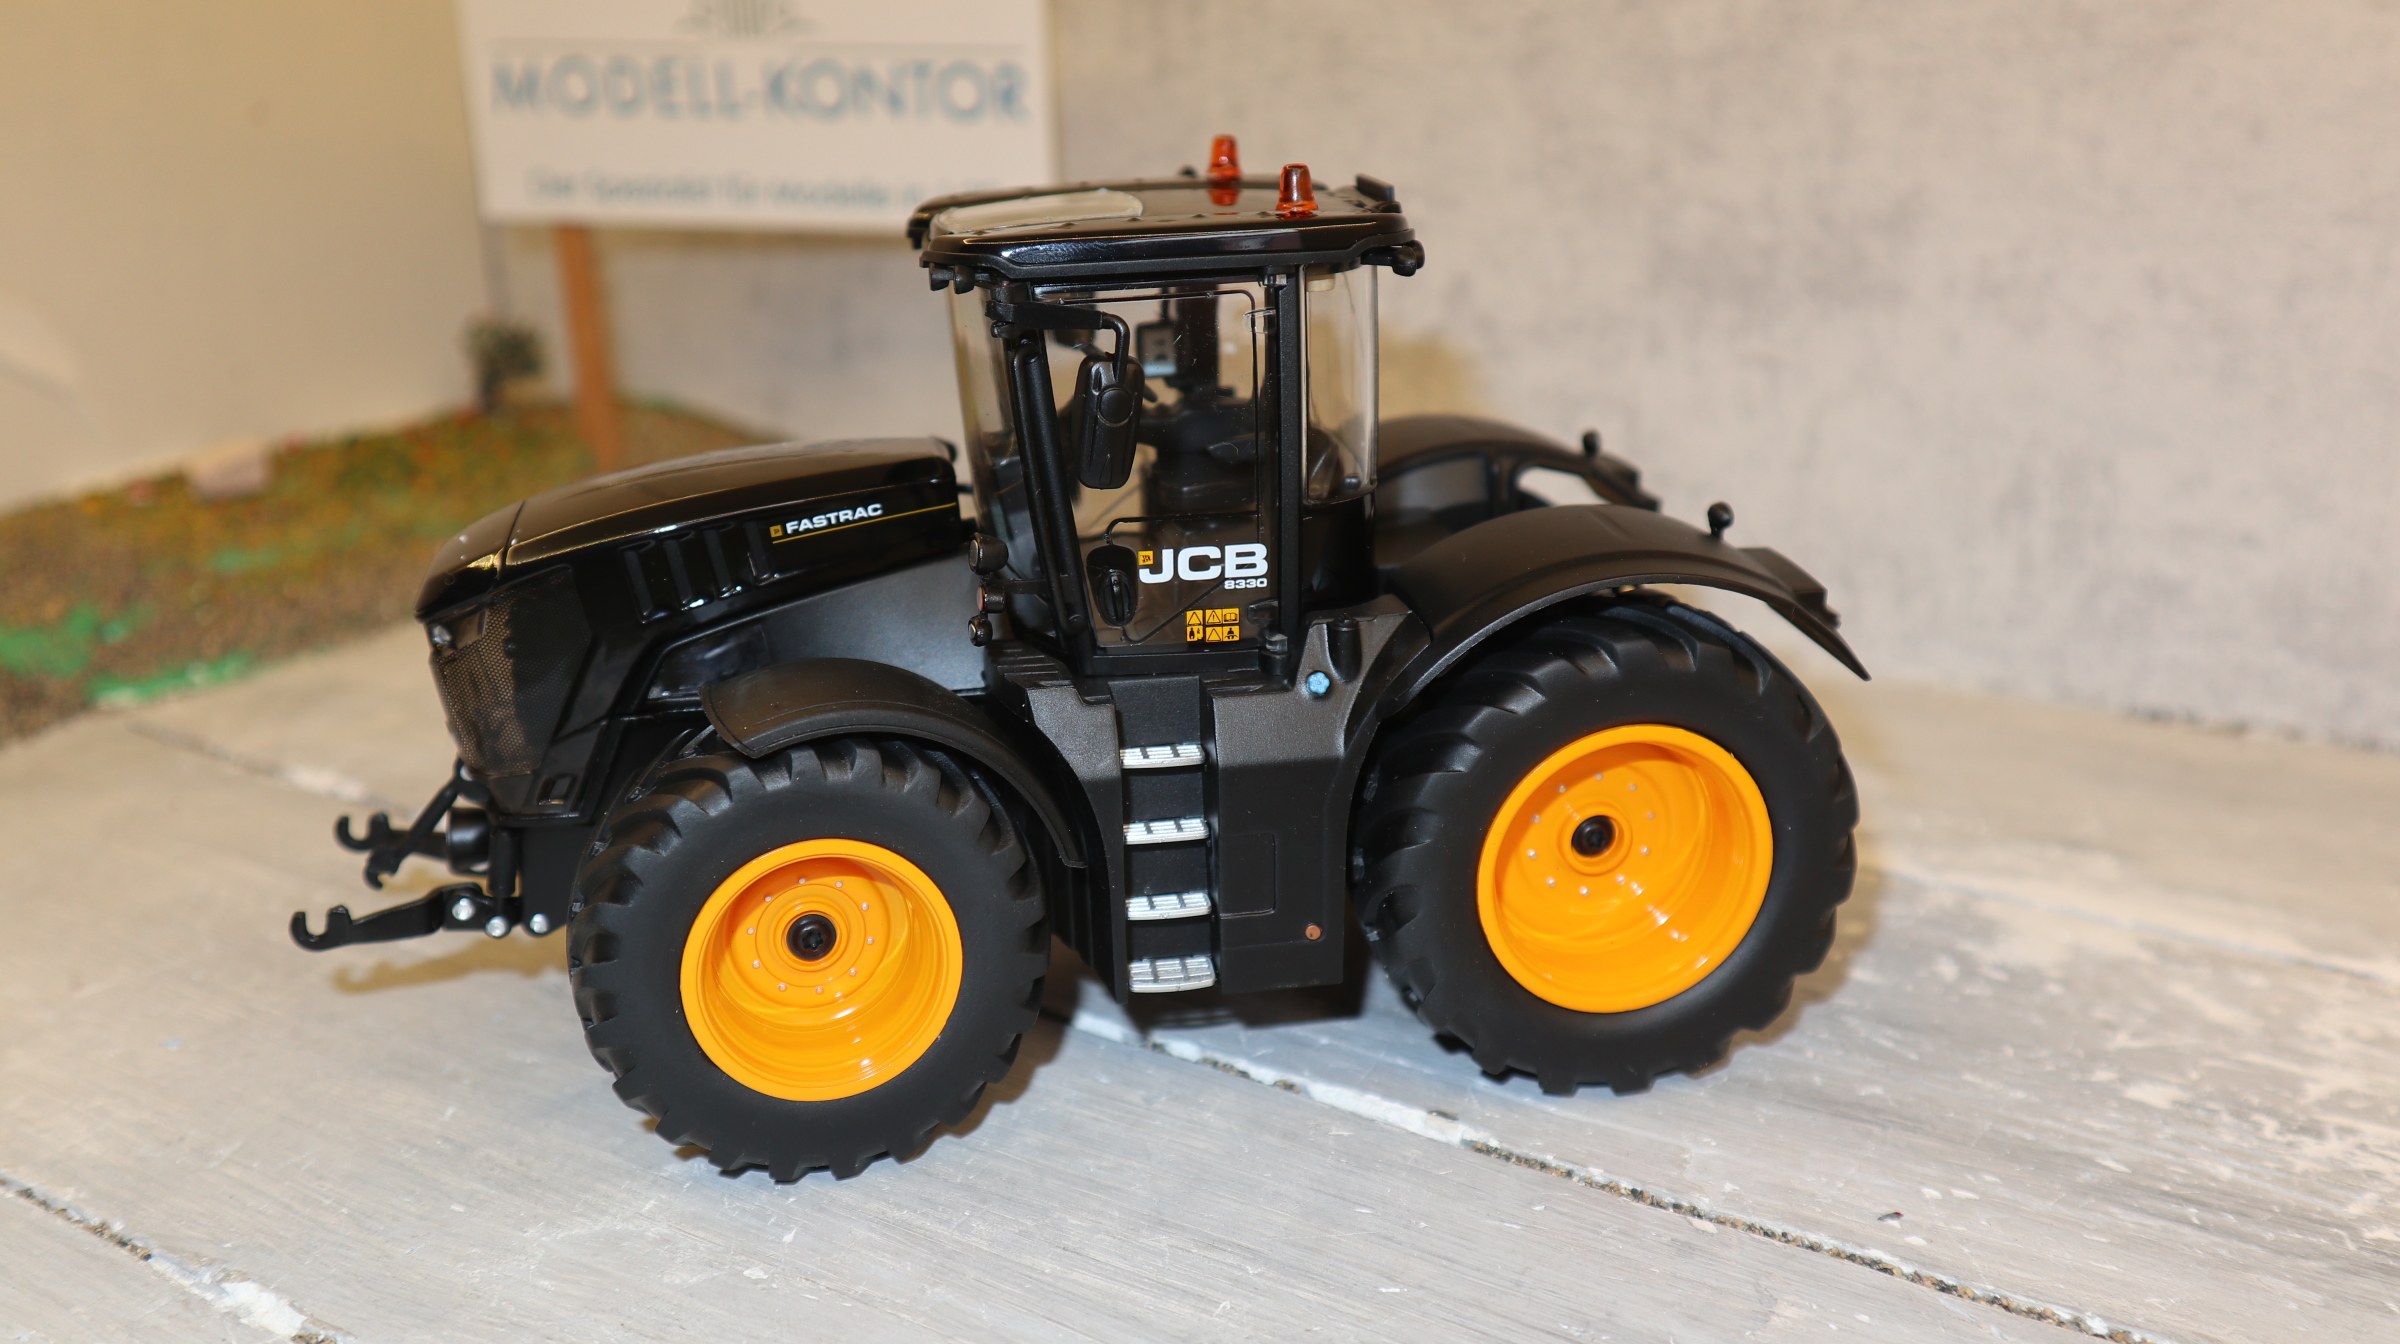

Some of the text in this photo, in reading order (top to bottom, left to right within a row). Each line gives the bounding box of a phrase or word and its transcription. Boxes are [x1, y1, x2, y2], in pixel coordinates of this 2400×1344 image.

[491, 56, 1030, 123] MODELL-KONTOR
[785, 503, 883, 534] FASTRAC
[1138, 543, 1269, 584] JCB
[1224, 578, 1268, 590] 8330
